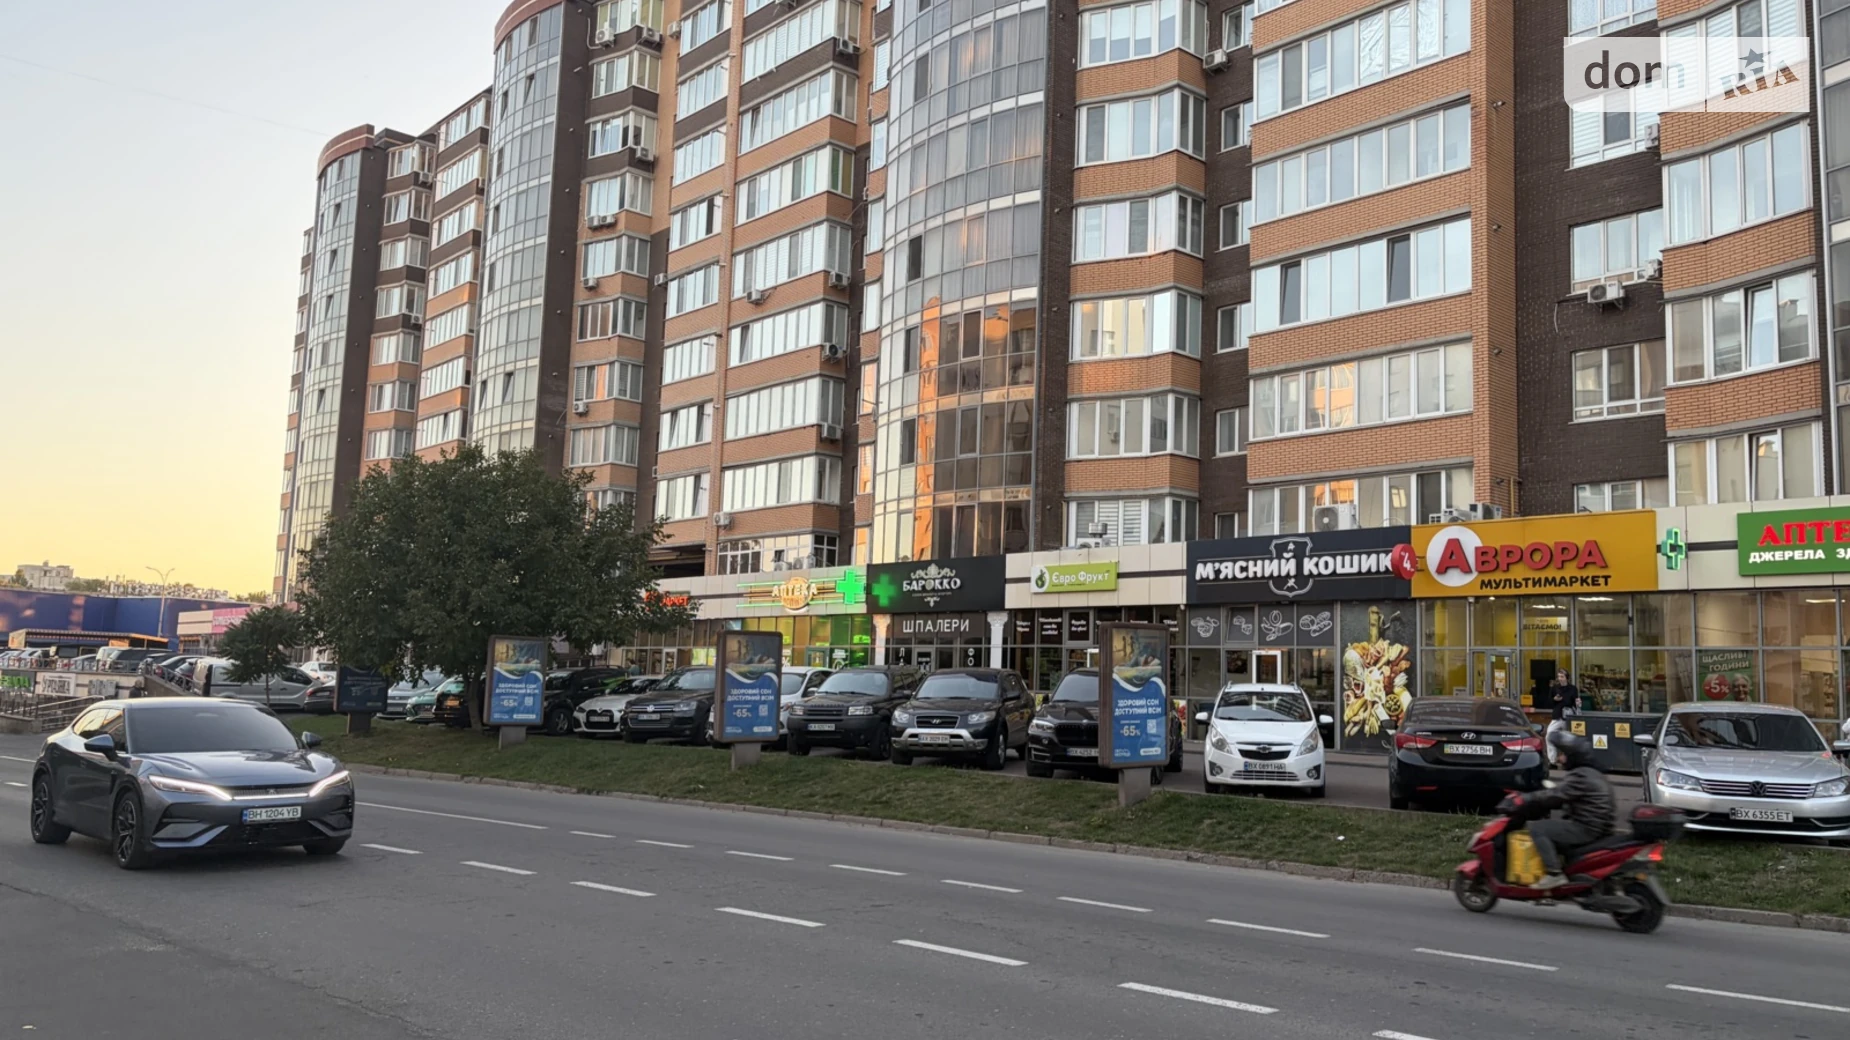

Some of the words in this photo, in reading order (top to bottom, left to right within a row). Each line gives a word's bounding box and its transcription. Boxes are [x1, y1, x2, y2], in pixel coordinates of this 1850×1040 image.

[1757, 520, 1850, 546] АПТЕ
[1749, 549, 1826, 563] ДЖЕРЕЛА
[1195, 551, 1297, 580] М'ЯСНИЙ
[1303, 553, 1392, 576] КОШИК
[903, 578, 961, 591] БАРОККО
[1052, 571, 1076, 586] Євро
[1078, 571, 1111, 584] Фрукт
[1480, 575, 1612, 590] МУЛЬТИМАРКЕТ
[771, 583, 818, 597] АПТЕКА
[902, 619, 970, 633] ШПАЛЕРИ
[1702, 651, 1747, 663] ЩАСЛИВІ
[1709, 661, 1749, 671] ГОДИНИ
[1704, 680, 1730, 693] -5%
[1117, 698, 1147, 707] ЗДОРОВИЙ
[1114, 706, 1148, 716] ДОСТУПНИЙ
[1148, 706, 1162, 714] ВСІМ
[248, 809, 262, 819] BH
[264, 808, 285, 818] 1204
[286, 807, 299, 817] YB
[1737, 808, 1750, 818] BX
[1752, 810, 1776, 820] 6355
[1776, 811, 1791, 820] ET
